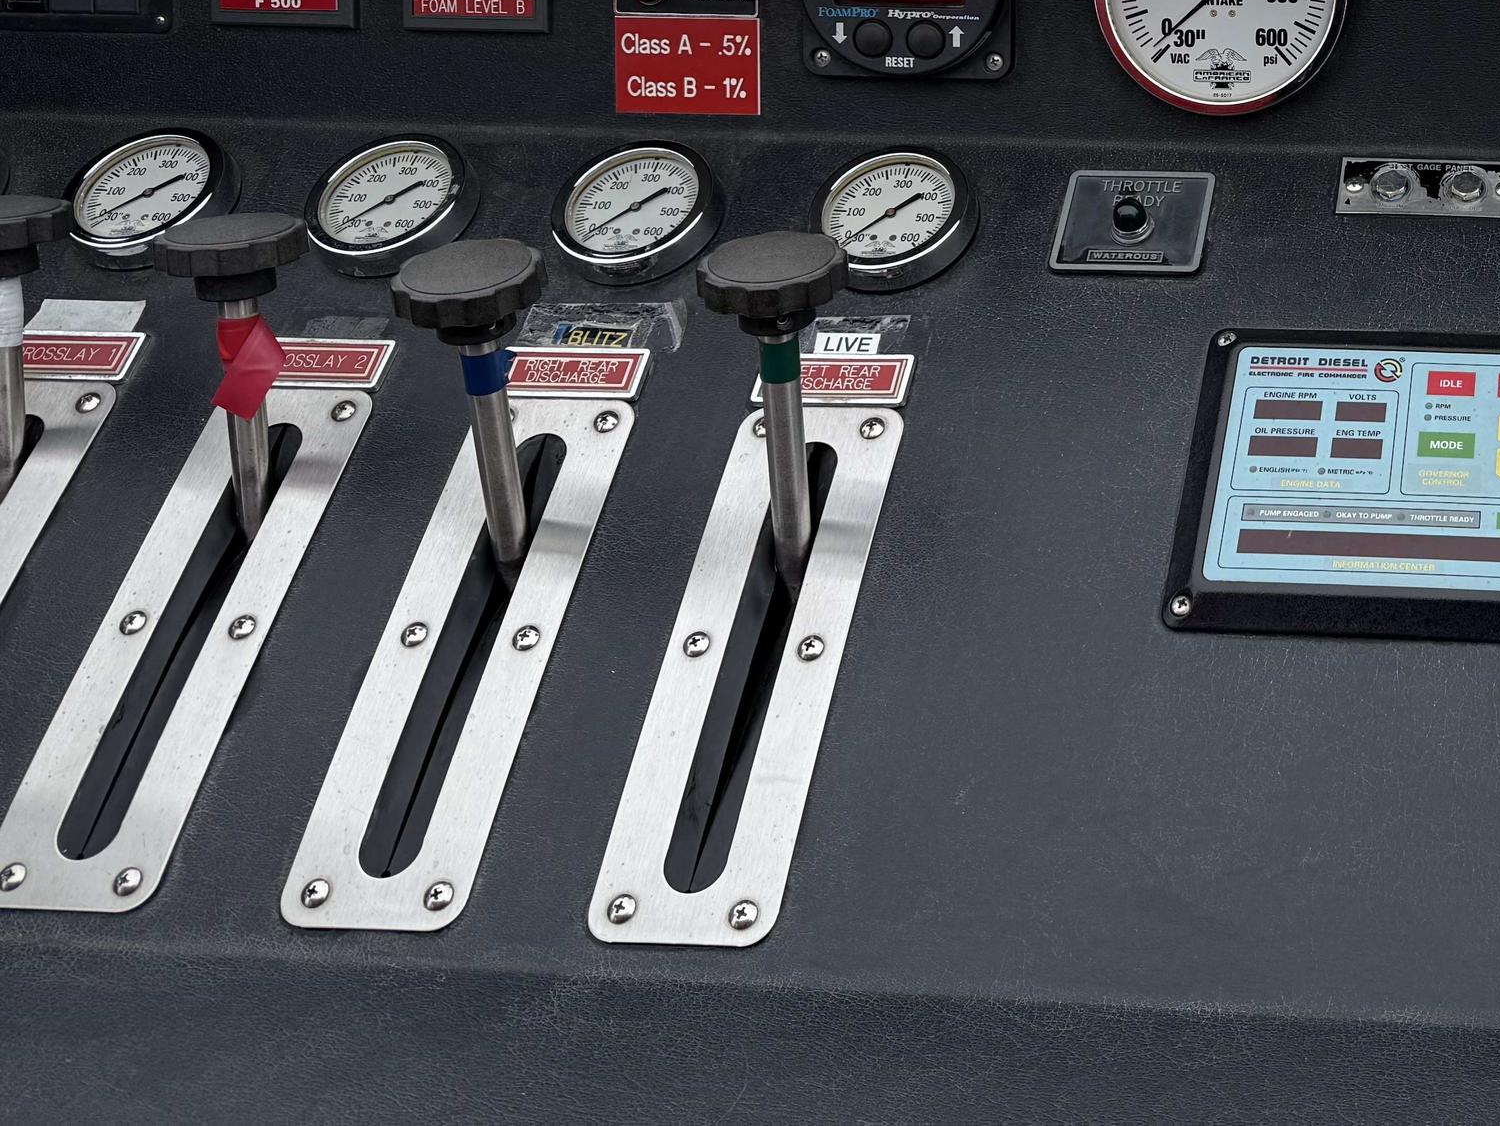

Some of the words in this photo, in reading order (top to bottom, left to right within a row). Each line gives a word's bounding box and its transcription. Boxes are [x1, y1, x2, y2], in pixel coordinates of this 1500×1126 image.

[421, 0, 458, 13] FOAM
[466, 0, 508, 14] LEVEL
[516, 0, 525, 14] B
[887, 9, 931, 20] Hypro
[1161, 18, 1172, 36] 0
[1173, 29, 1206, 48] 30"
[1255, 28, 1288, 47] 600
[621, 33, 670, 55] Class
[678, 34, 692, 55] A
[718, 35, 752, 56] .5%
[885, 57, 915, 68] RESET
[1170, 53, 1190, 65] VAC
[1263, 53, 1278, 67] psi
[627, 75, 676, 98] Class
[684, 77, 697, 98] B
[723, 77, 747, 99] 1%
[159, 160, 178, 169] 300
[1417, 163, 1441, 171] GAGE
[1445, 164, 1474, 172] PANEL
[127, 168, 146, 176] 200
[399, 167, 417, 175] 300
[367, 175, 386, 183] 200
[641, 174, 660, 182] 300
[610, 181, 629, 190] 200
[893, 180, 913, 188] 300
[1102, 180, 1184, 193] THROTTLE
[106, 187, 125, 195] 100
[862, 188, 882, 196] 200
[171, 193, 191, 202] 500
[348, 194, 367, 202] 100
[413, 200, 432, 209] 500
[592, 201, 612, 209] 100
[660, 208, 679, 216] 500
[846, 207, 865, 216] 100
[151, 212, 171, 222] 600
[915, 213, 935, 222] 500
[395, 219, 414, 228] 600
[643, 226, 663, 236] 600
[900, 233, 920, 242] 600
[1092, 252, 1158, 260] WATEROUS
[566, 330, 628, 348] BLITZ
[823, 336, 873, 352] LIVE
[22, 346, 101, 361] ROSSLAY
[283, 353, 348, 369] OSSLAY
[354, 355, 368, 369] 2
[1251, 356, 1309, 366] DETROIT
[1318, 358, 1368, 367] DIESEL
[524, 359, 570, 372] RIGHT
[577, 360, 619, 373] REAR
[800, 365, 830, 377] EFT
[839, 365, 881, 378] REAR
[525, 371, 609, 384] DISCHARGE
[800, 377, 875, 390] ISCHARGE
[1440, 379, 1463, 388] IDLE
[1264, 391, 1296, 399] ENGINE
[1430, 440, 1463, 450] MODE
[1280, 479, 1313, 488] ENGINE
[1316, 480, 1341, 488] DATA
[1410, 514, 1448, 522] THROTTLE
